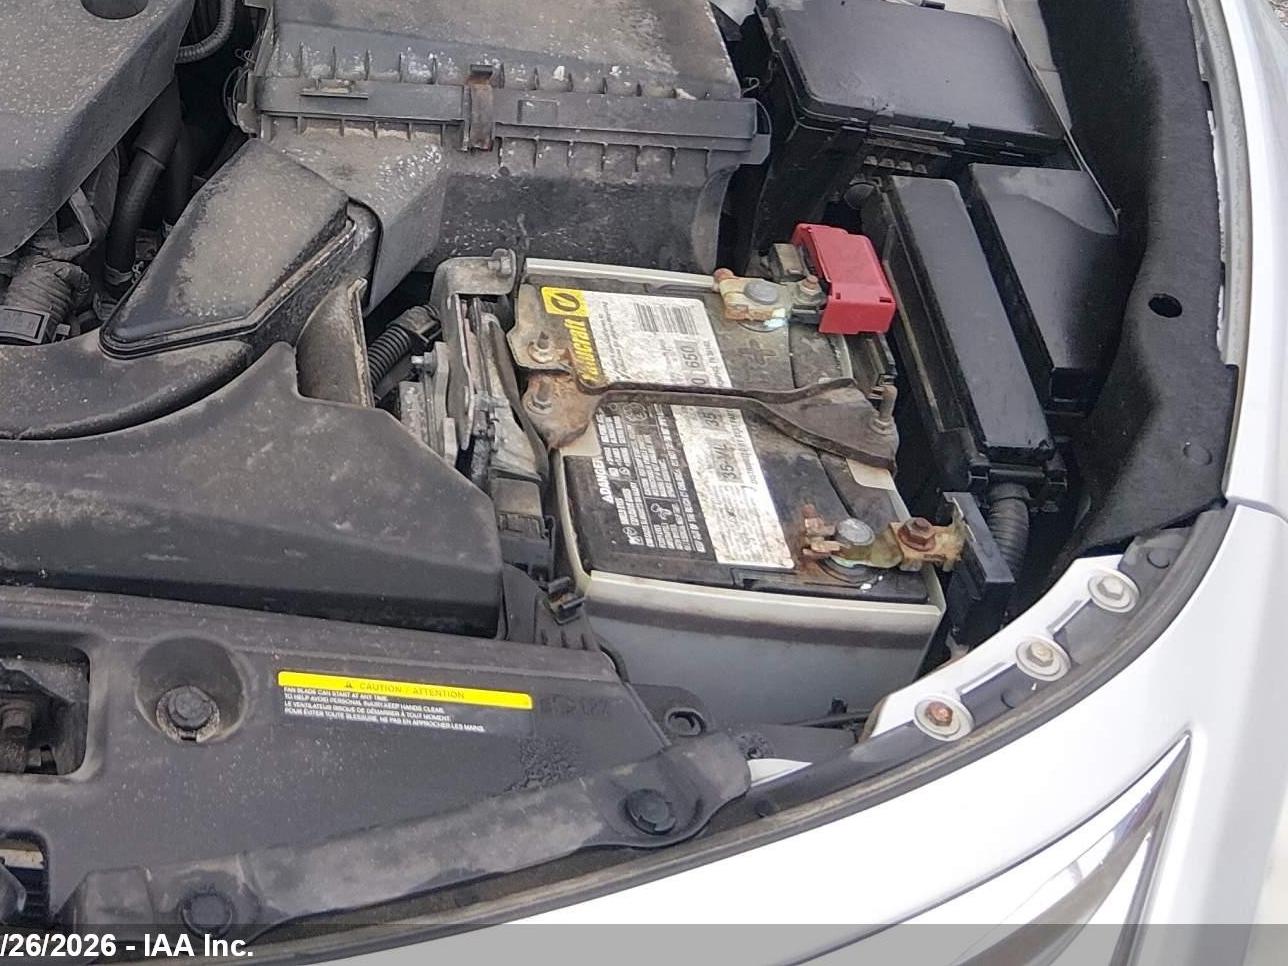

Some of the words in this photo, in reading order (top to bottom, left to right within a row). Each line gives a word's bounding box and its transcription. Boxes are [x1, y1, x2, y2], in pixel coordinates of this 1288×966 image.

[681, 344, 700, 369] 650
[704, 410, 720, 428] 35
[359, 682, 401, 693] CAUTION
[412, 687, 464, 699] ATTENTION
